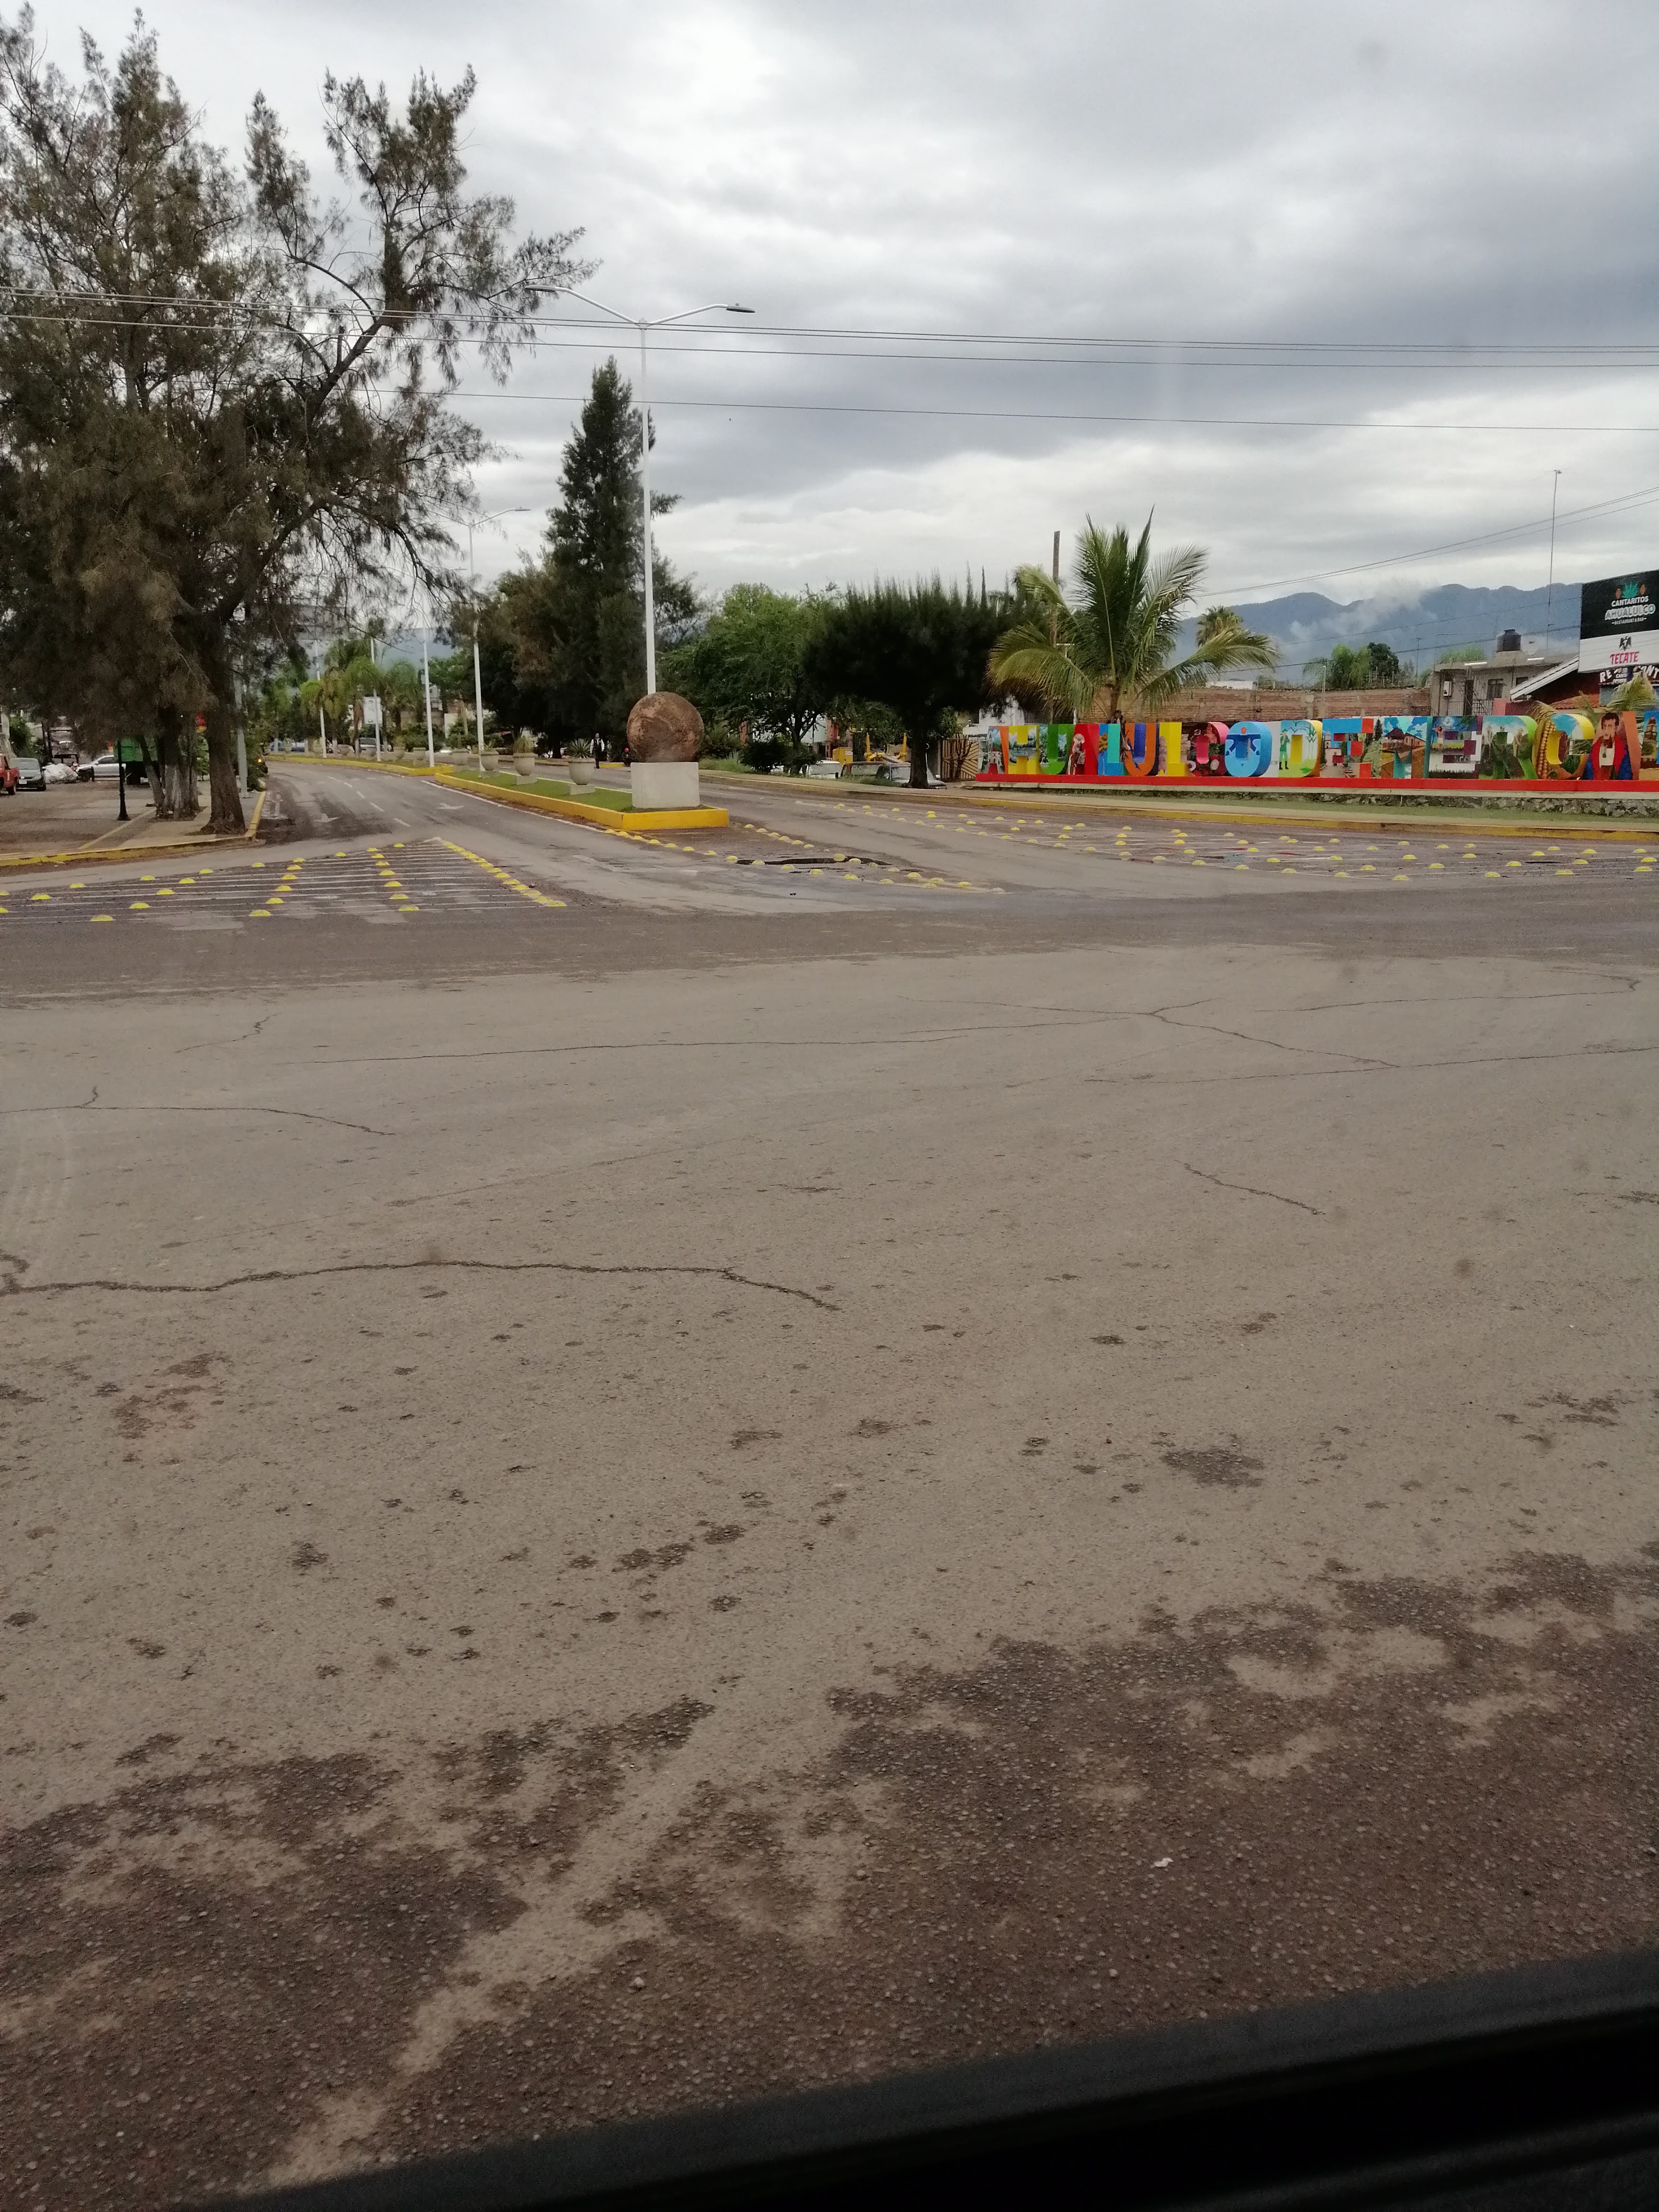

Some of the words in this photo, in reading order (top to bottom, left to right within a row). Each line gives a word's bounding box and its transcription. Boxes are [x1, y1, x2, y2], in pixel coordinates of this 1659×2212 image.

[1611, 595, 1648, 607] CANTARITOS
[1605, 604, 1656, 620] AHUALULCO
[1610, 651, 1640, 665] TECATE
[978, 720, 1272, 777] AHUALULCO
[1270, 718, 1381, 777] DE
